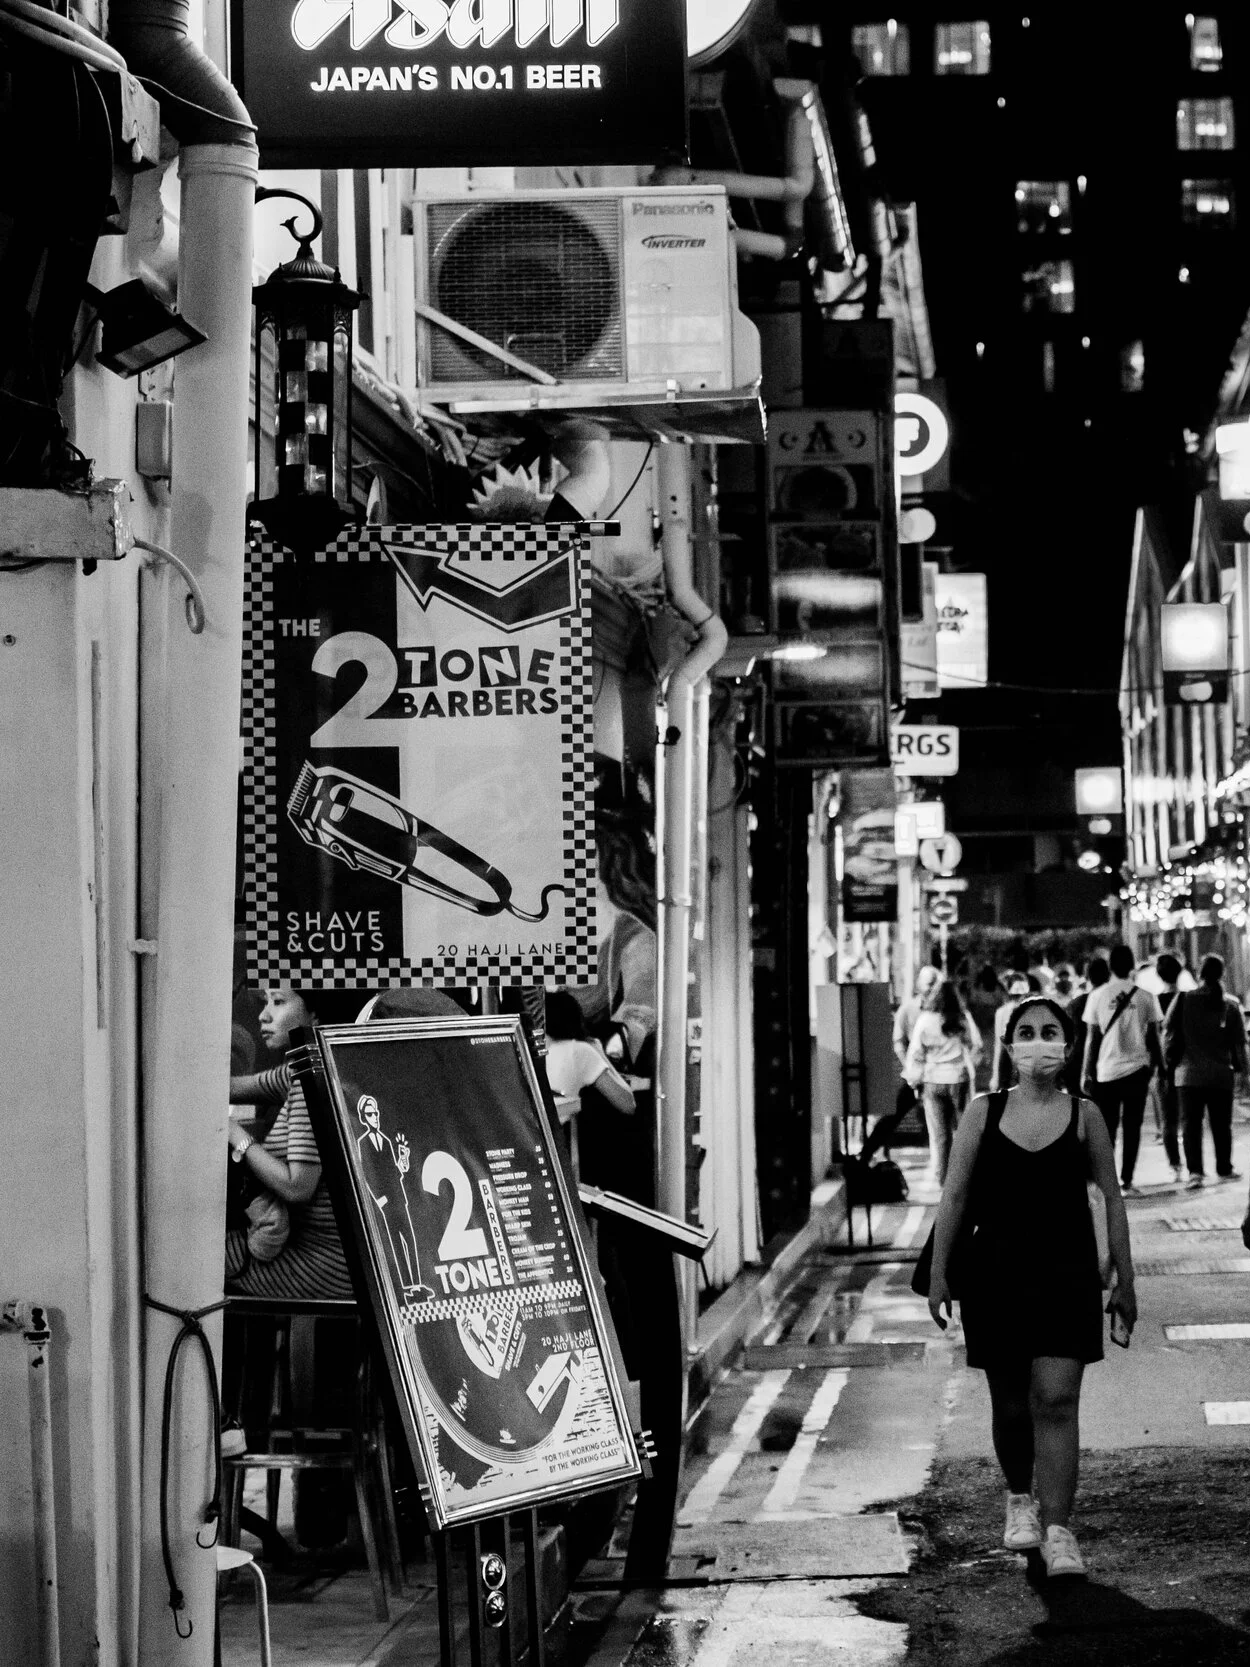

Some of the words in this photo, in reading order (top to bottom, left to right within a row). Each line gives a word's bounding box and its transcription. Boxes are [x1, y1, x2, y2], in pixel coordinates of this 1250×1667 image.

[310, 64, 438, 92] JAPAN'S
[450, 64, 514, 91] NO.1
[526, 64, 602, 89] BEER
[631, 201, 715, 217] Panasonic
[646, 238, 706, 249] INVERTER
[278, 619, 321, 637] THE
[311, 630, 400, 748] 2
[400, 647, 555, 687] TONE
[401, 687, 560, 719] BARBERS
[890, 734, 951, 756] RGS
[287, 911, 381, 932] SHAVE
[437, 944, 459, 957] 20
[467, 943, 510, 956] HAJI
[517, 942, 564, 956] LANE
[421, 1150, 489, 1262] 2
[482, 1184, 511, 1284] BARBERS
[434, 1257, 501, 1295] TONE
[535, 1304, 543, 1312] TO
[541, 1336, 552, 1347] 20
[553, 1332, 572, 1344] HAJI
[573, 1328, 593, 1341] LANE
[552, 1342, 568, 1353] 2ND
[570, 1338, 595, 1350] FLOOR
[558, 1449, 570, 1460] THE
[571, 1442, 600, 1455] WORKING
[600, 1437, 619, 1448] CLASS
[549, 1464, 557, 1474] BY
[557, 1461, 570, 1471] THE
[570, 1453, 600, 1467] WORKING
